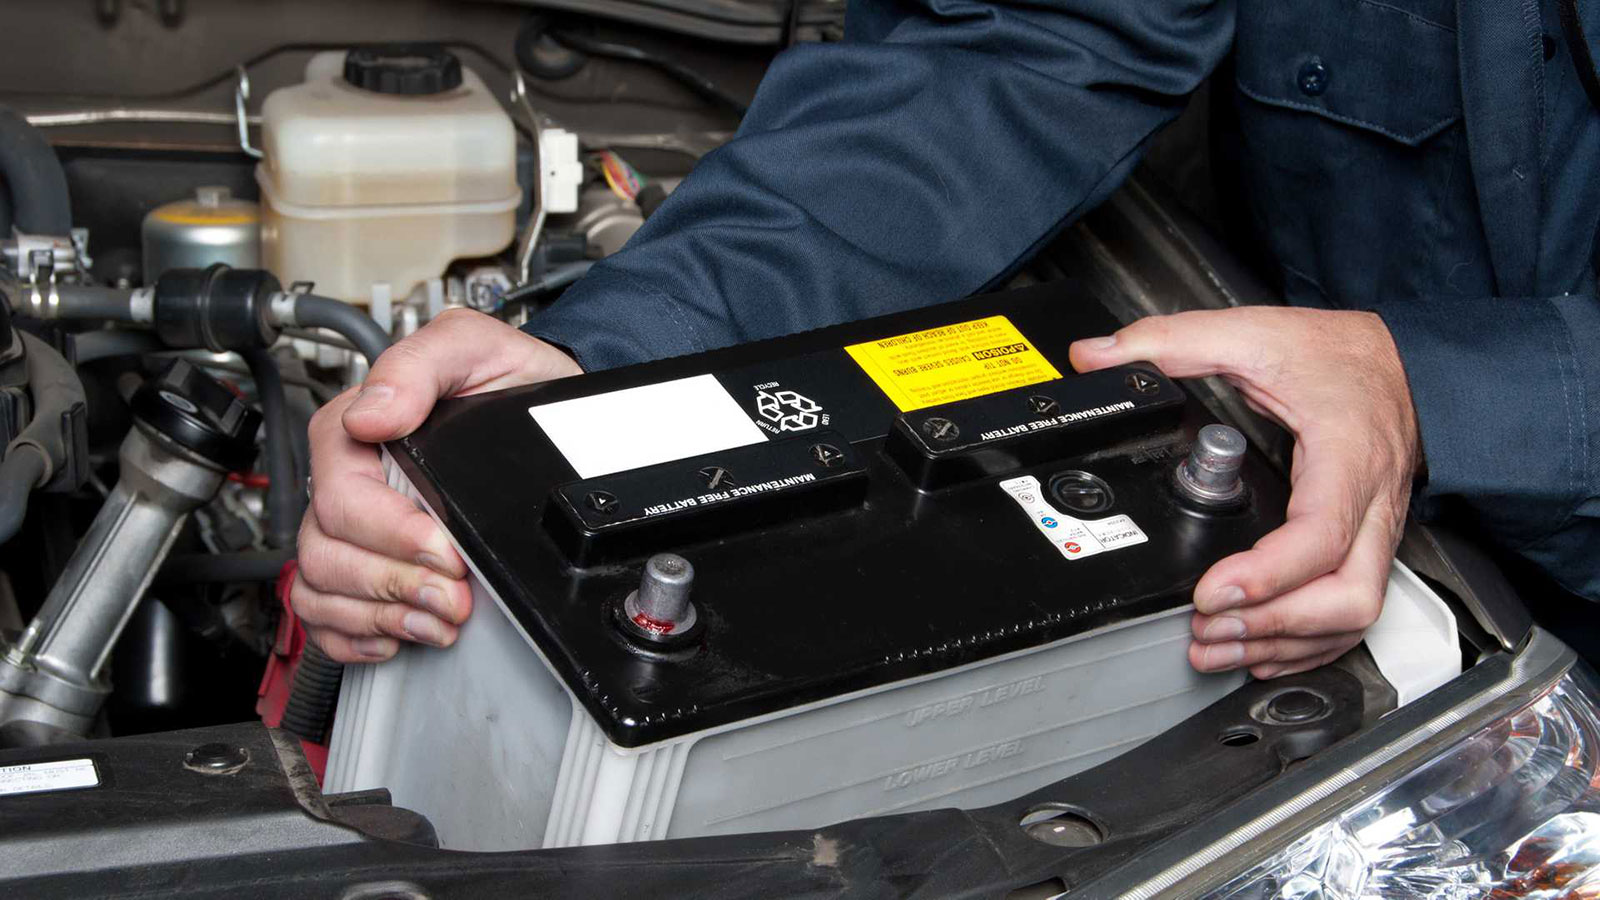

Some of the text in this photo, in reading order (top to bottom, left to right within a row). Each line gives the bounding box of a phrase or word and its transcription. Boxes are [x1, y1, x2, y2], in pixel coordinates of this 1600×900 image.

[956, 324, 971, 332] OUT
[971, 320, 989, 329] KEEP
[912, 333, 923, 341] OF
[922, 329, 946, 339] REACH
[877, 336, 913, 348] CHILDREN
[974, 345, 1017, 359] POISON
[918, 360, 943, 371] SEVERE
[943, 354, 972, 366] CAUSES
[982, 356, 1024, 370] DO NOT TIP
[892, 366, 918, 377] BURNS
[753, 381, 780, 391] RECYCLE
[821, 414, 830, 425] LEAD
[980, 401, 1135, 441] MAINTENANCE FREE BATTERY
[755, 420, 780, 434] RETURN
[643, 473, 816, 516] MAINTENANCE FREE BATTERY
[1100, 530, 1139, 543] INDICATOR
[905, 677, 1047, 727] UPPER LEVEL
[883, 740, 1025, 791] LOWER LEVEL
